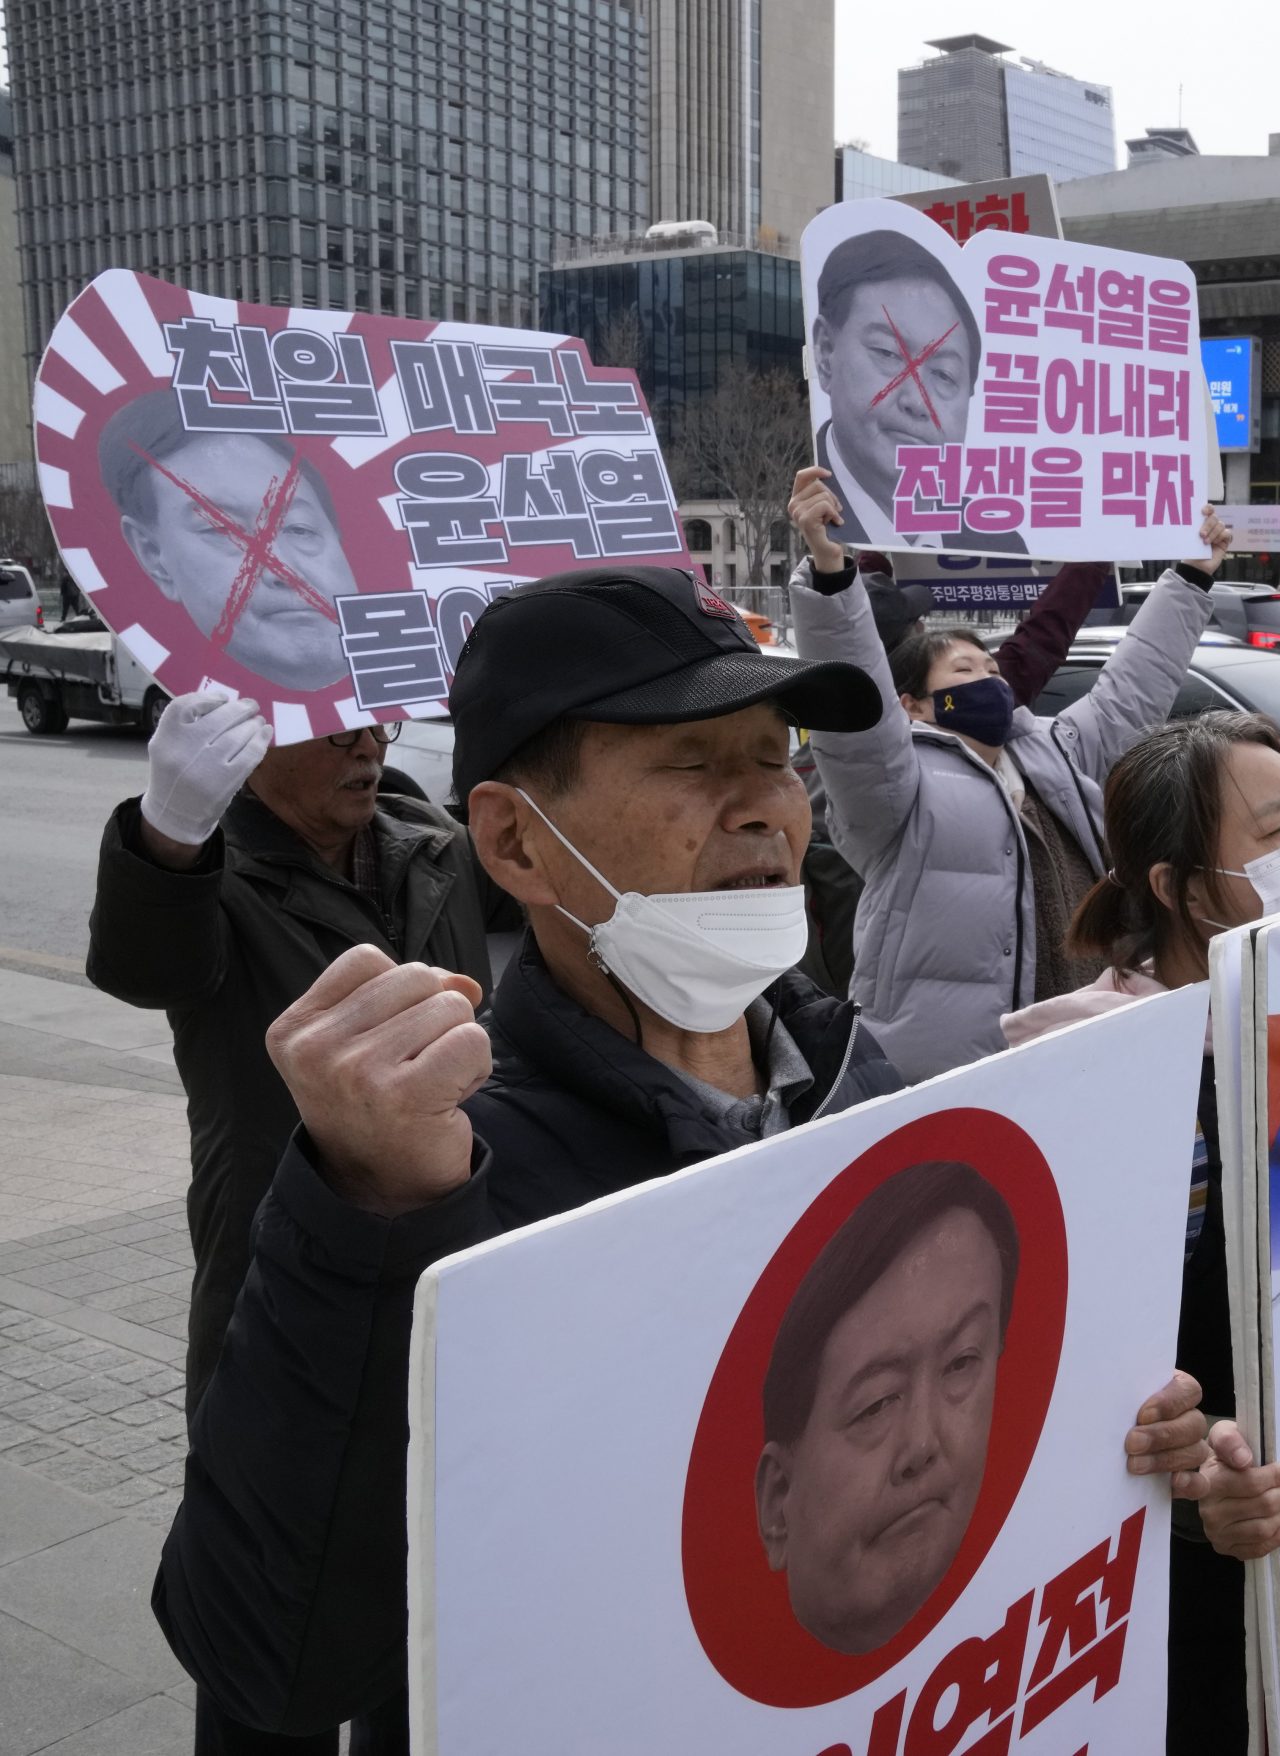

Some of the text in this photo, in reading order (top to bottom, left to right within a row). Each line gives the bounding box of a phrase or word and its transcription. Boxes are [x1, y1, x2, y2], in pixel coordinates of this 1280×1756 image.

[984, 254, 1191, 356] 윤석열을
[164, 317, 652, 437] 친일 매국노
[983, 352, 1191, 441] 끌어내려
[394, 449, 685, 570] 윤석열
[894, 443, 1194, 535] 전쟁을 막자
